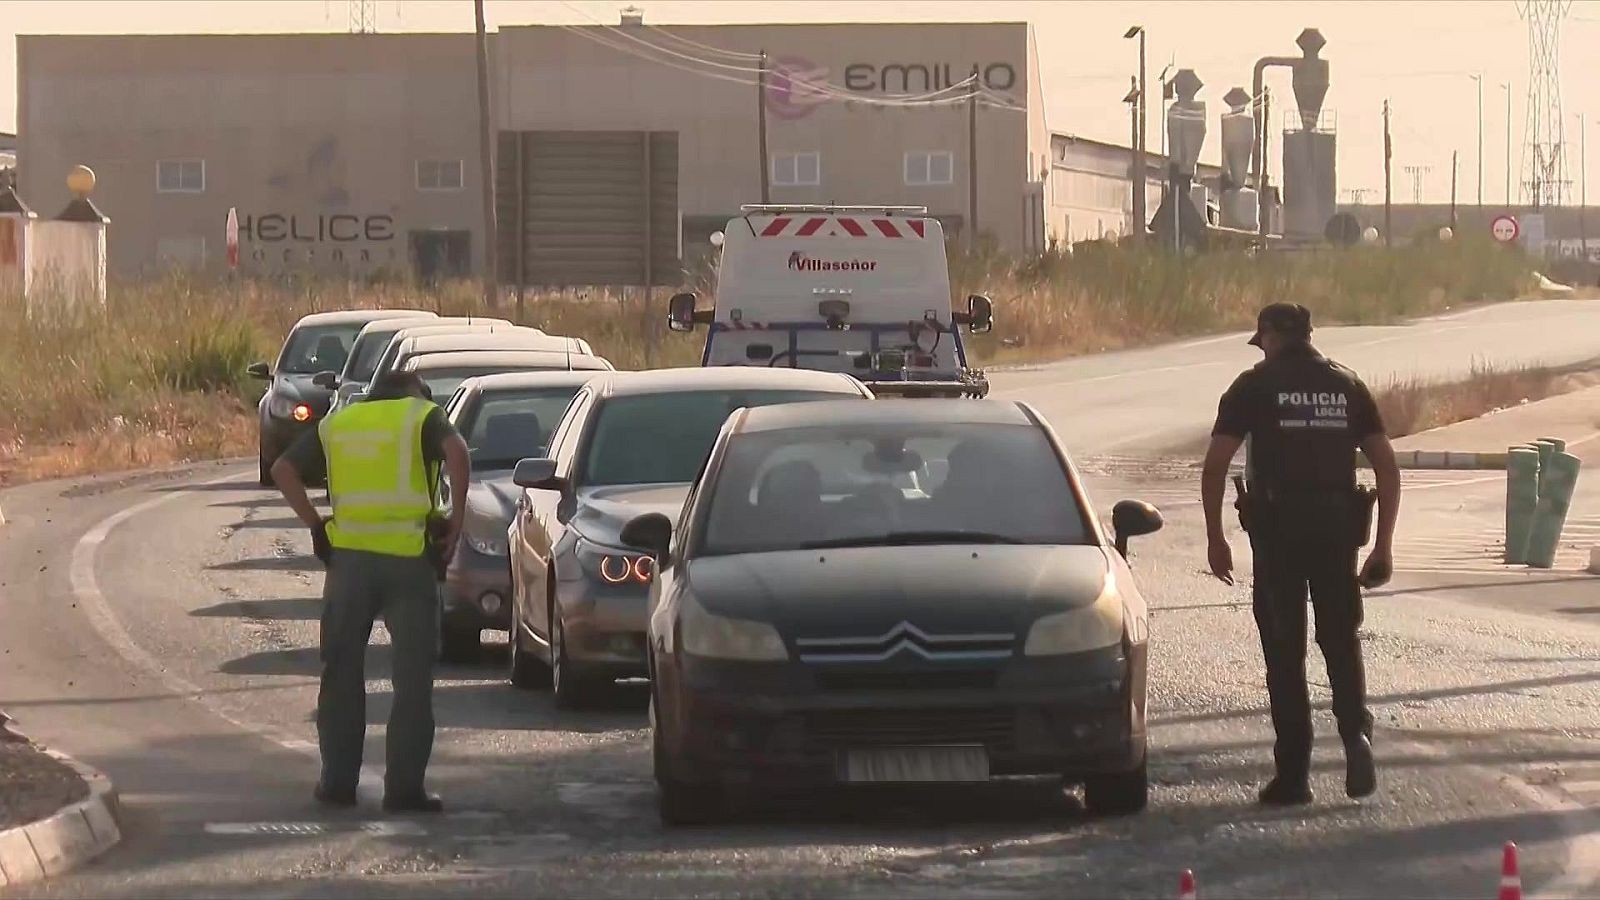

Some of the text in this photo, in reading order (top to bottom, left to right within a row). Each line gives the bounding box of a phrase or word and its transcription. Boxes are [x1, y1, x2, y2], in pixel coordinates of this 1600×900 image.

[796, 256, 877, 271] Villaseñor
[1278, 392, 1348, 406] POLICIA
[1315, 407, 1348, 417] LOCAL
